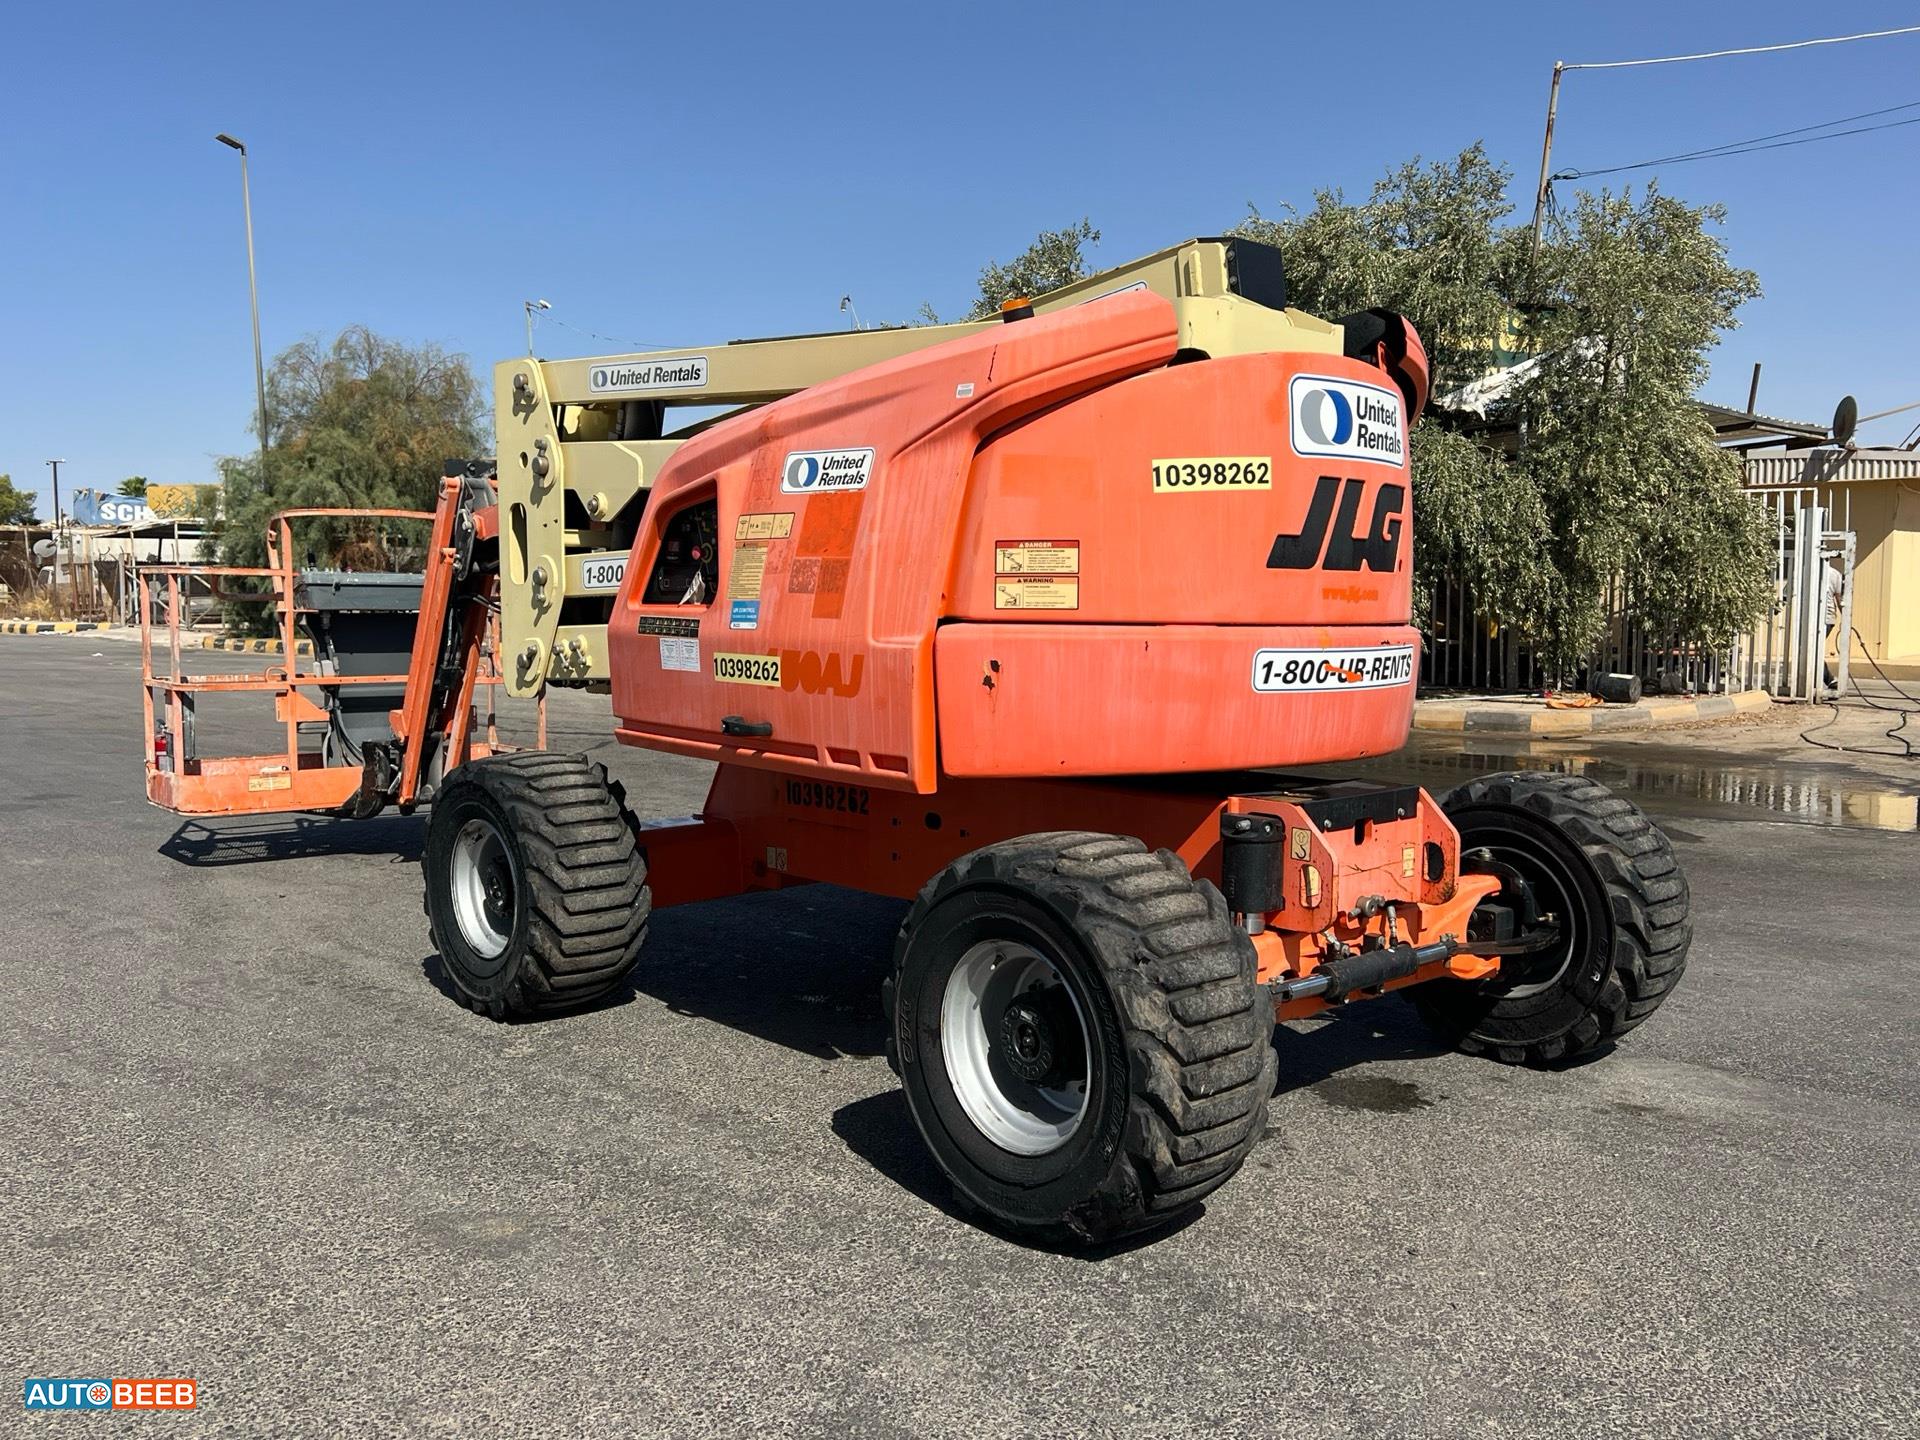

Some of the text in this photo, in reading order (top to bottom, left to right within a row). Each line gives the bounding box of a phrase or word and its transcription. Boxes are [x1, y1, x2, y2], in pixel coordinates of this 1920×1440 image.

[610, 364, 701, 386] United Rentals
[1356, 395, 1397, 428] United
[1357, 423, 1401, 454] Rentals
[822, 454, 866, 471] United
[1152, 462, 1270, 487] 10398262
[818, 470, 865, 486] Rentals
[1266, 475, 1405, 573] JLG
[713, 657, 780, 682] 10398262
[1261, 653, 1412, 685] 1-800-UR-RENTS
[785, 779, 870, 816] 10398262
